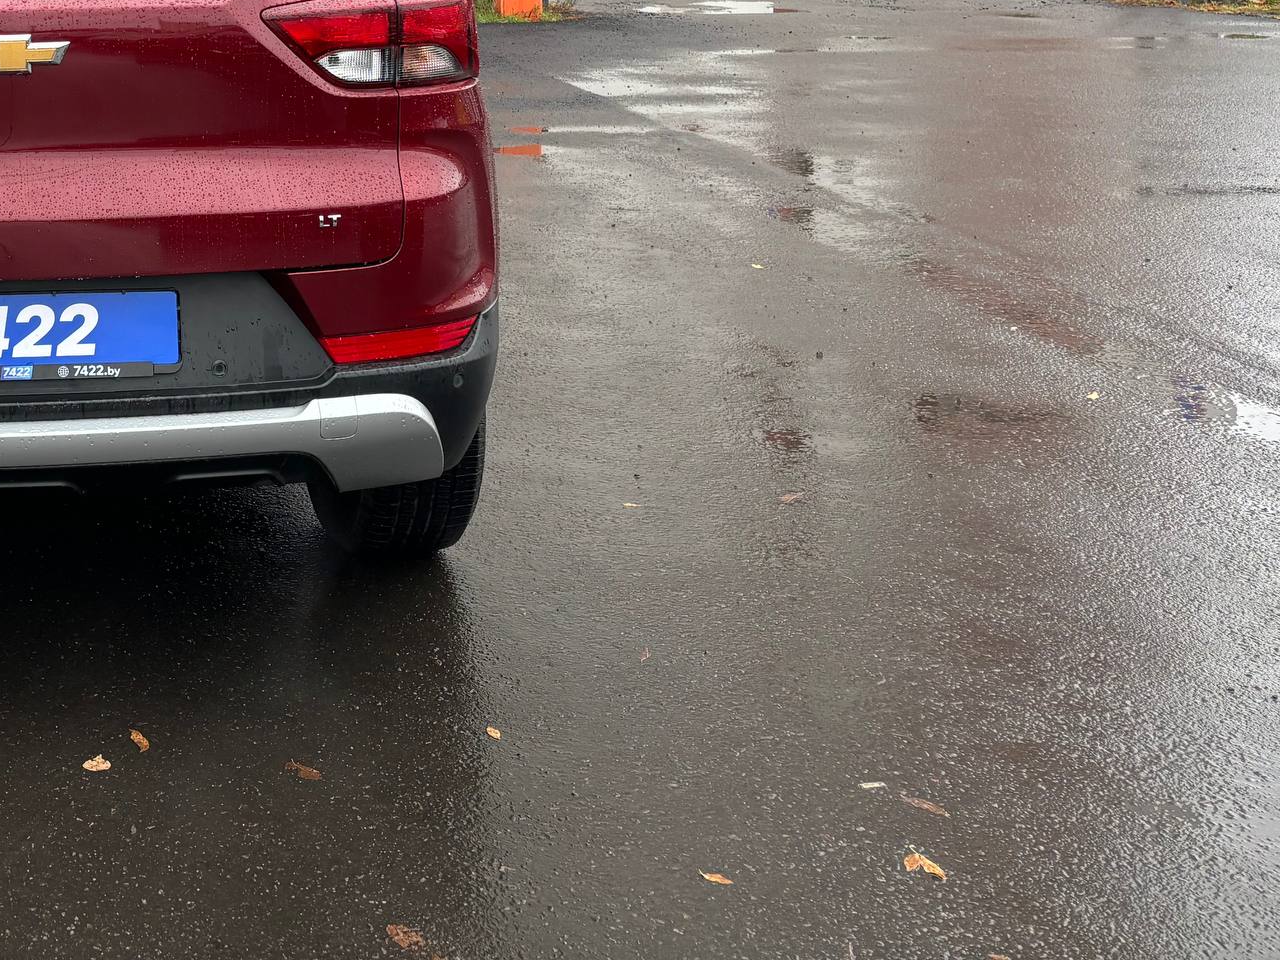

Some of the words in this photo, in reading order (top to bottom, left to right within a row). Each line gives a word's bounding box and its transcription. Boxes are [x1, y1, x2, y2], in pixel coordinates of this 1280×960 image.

[318, 214, 342, 228] LT
[3, 366, 32, 378] 7422
[73, 365, 121, 378] 7422.by
